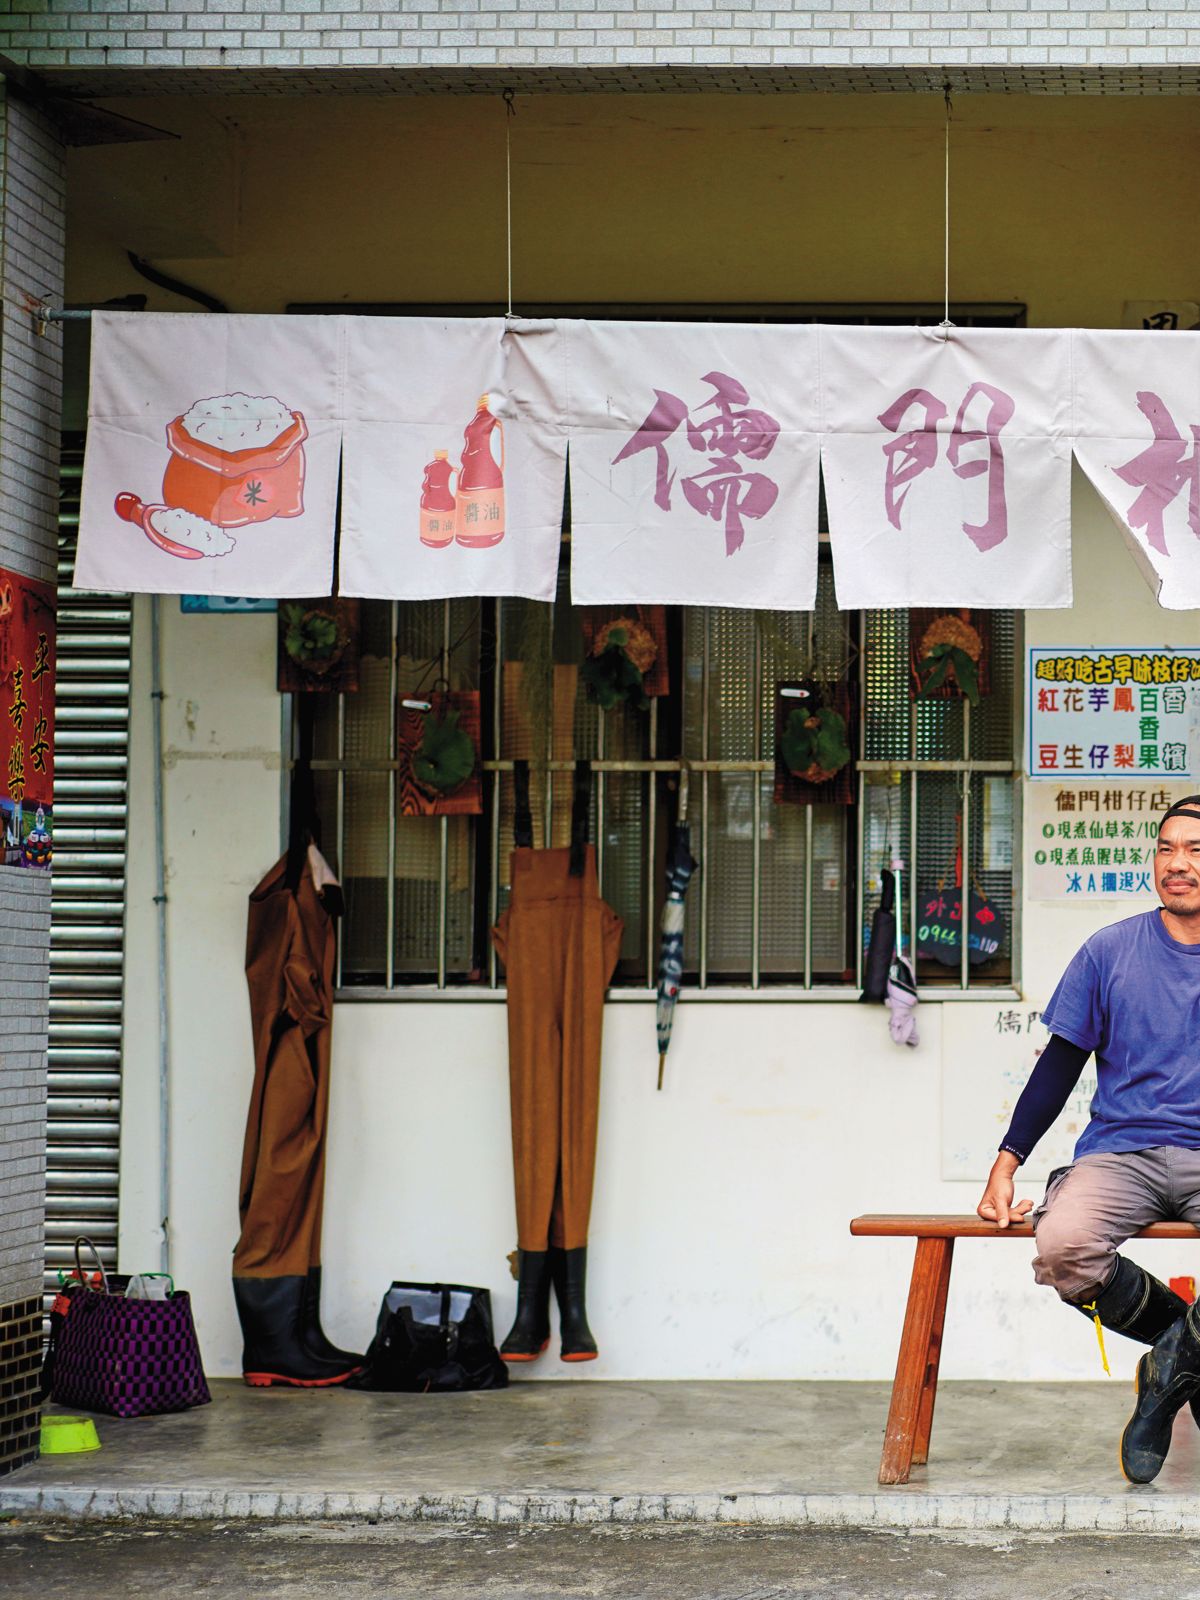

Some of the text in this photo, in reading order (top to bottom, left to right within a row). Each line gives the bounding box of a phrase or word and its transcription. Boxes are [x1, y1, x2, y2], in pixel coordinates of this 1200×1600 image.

[244, 479, 268, 507] 米
[464, 502, 500, 523] 醬油
[1038, 688, 1059, 769] 紅豆
[1063, 688, 1084, 769] 花生
[1088, 688, 1110, 769] 芋仔
[1113, 688, 1135, 769] 鳳梨
[1138, 688, 1160, 769] 百香果
[1055, 790, 1172, 812] 儒門柑仔店
[1057, 820, 1161, 839] 現煮仙草茶/10
